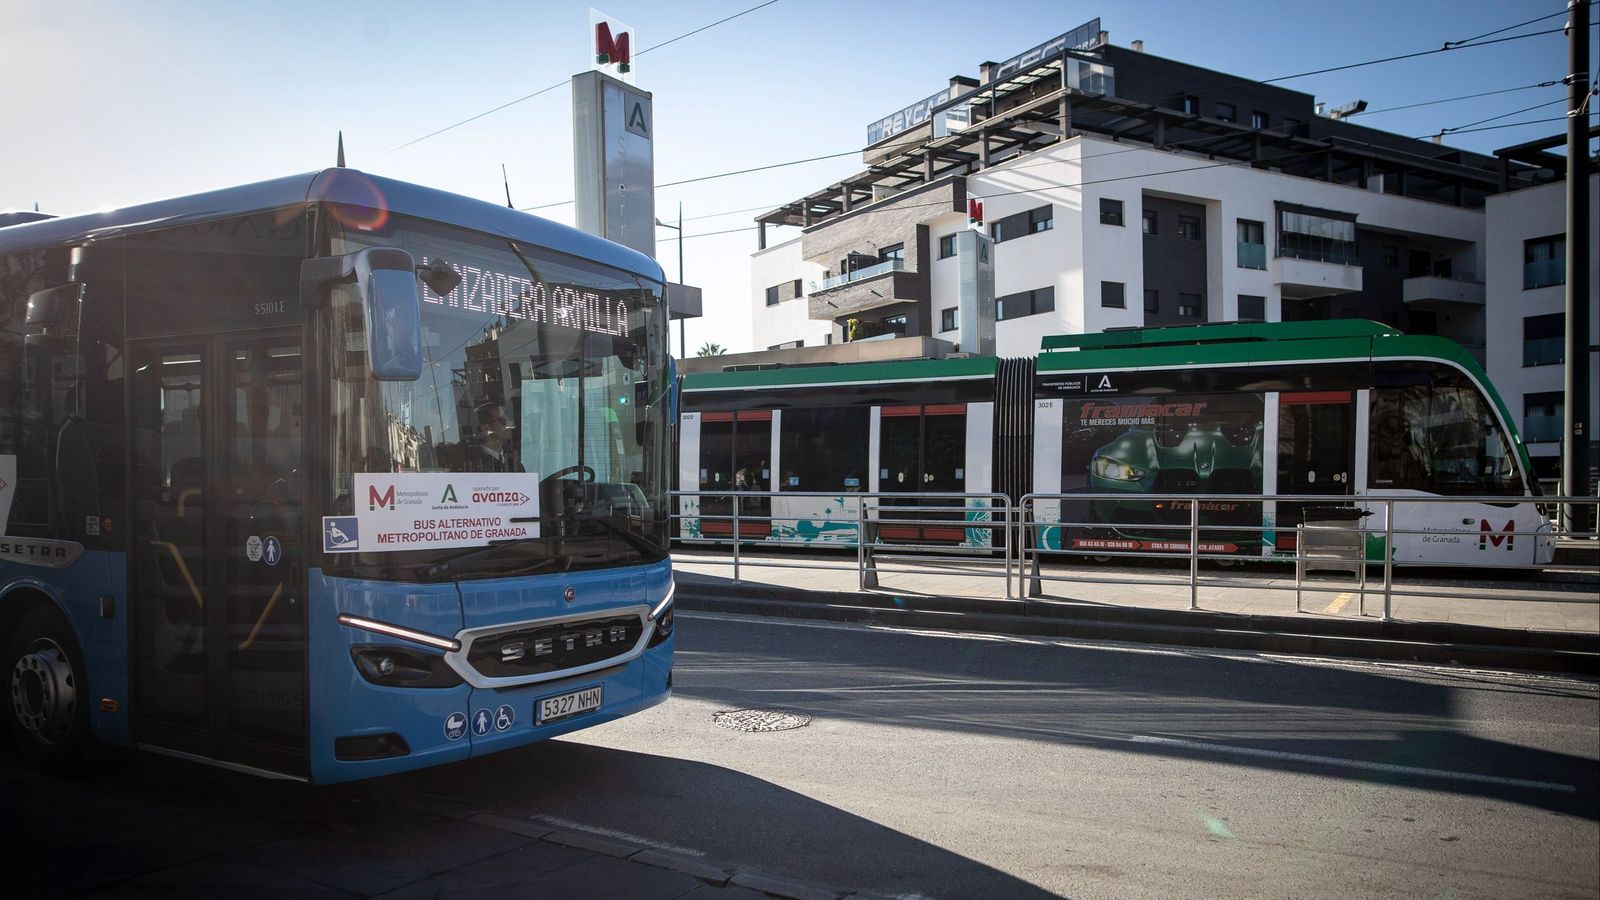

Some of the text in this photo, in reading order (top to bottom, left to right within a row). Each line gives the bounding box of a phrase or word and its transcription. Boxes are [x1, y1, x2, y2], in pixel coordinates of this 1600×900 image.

[423, 256, 629, 338] LNZADERA ARMILLA
[1080, 402, 1207, 418] framacar
[1080, 416, 1155, 426] TE MERECES MUCHO MÁS
[369, 485, 395, 511] M
[472, 492, 519, 503] avanza
[413, 517, 501, 530] BUS ALTERNATIVO
[377, 527, 527, 544] METROPOLITANO DE GRANADA
[1432, 535, 1460, 544] Granada
[0, 543, 66, 558] SETRA
[501, 626, 626, 662] SETRA
[544, 689, 600, 717] 5327 NHN
